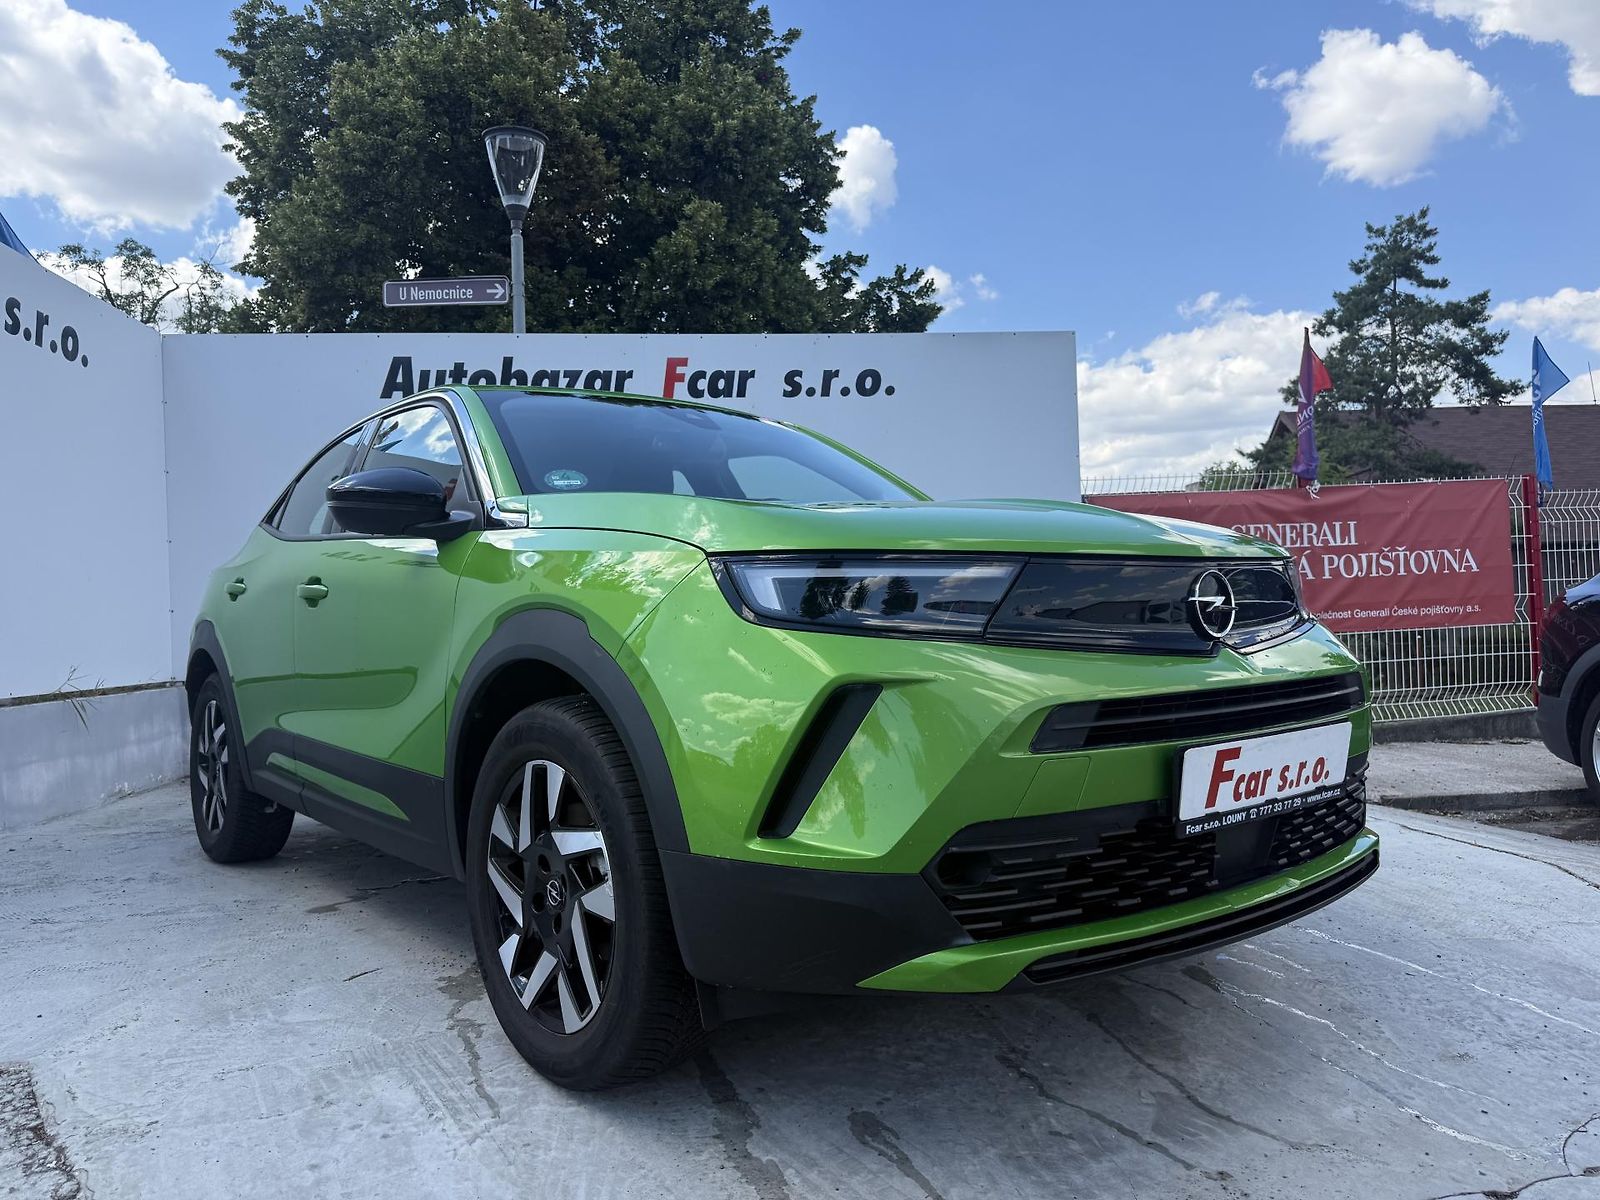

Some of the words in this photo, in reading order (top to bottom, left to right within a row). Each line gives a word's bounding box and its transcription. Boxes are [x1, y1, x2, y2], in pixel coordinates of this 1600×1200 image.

[399, 286, 407, 301] U
[410, 285, 473, 301] Nemocnice
[4, 296, 89, 368] s.r.o.
[380, 356, 633, 399] Autobazar
[663, 357, 756, 399] Fcar
[782, 368, 896, 398] s.r.o.
[1321, 545, 1480, 580] POJIŠŤOVNA
[1353, 607, 1390, 618] Generali
[1391, 605, 1418, 617] České
[1420, 605, 1464, 616] pojišťovny
[1466, 604, 1482, 613] a.s.
[1205, 746, 1273, 809] Fcar
[1277, 756, 1330, 793] s.r.o.
[1186, 823, 1203, 834] Fcar
[1203, 820, 1221, 831] s.r.o.
[1222, 811, 1247, 826] LOUNY
[1259, 804, 1273, 816] 777
[1273, 802, 1283, 812] 33
[1283, 799, 1292, 810] 77
